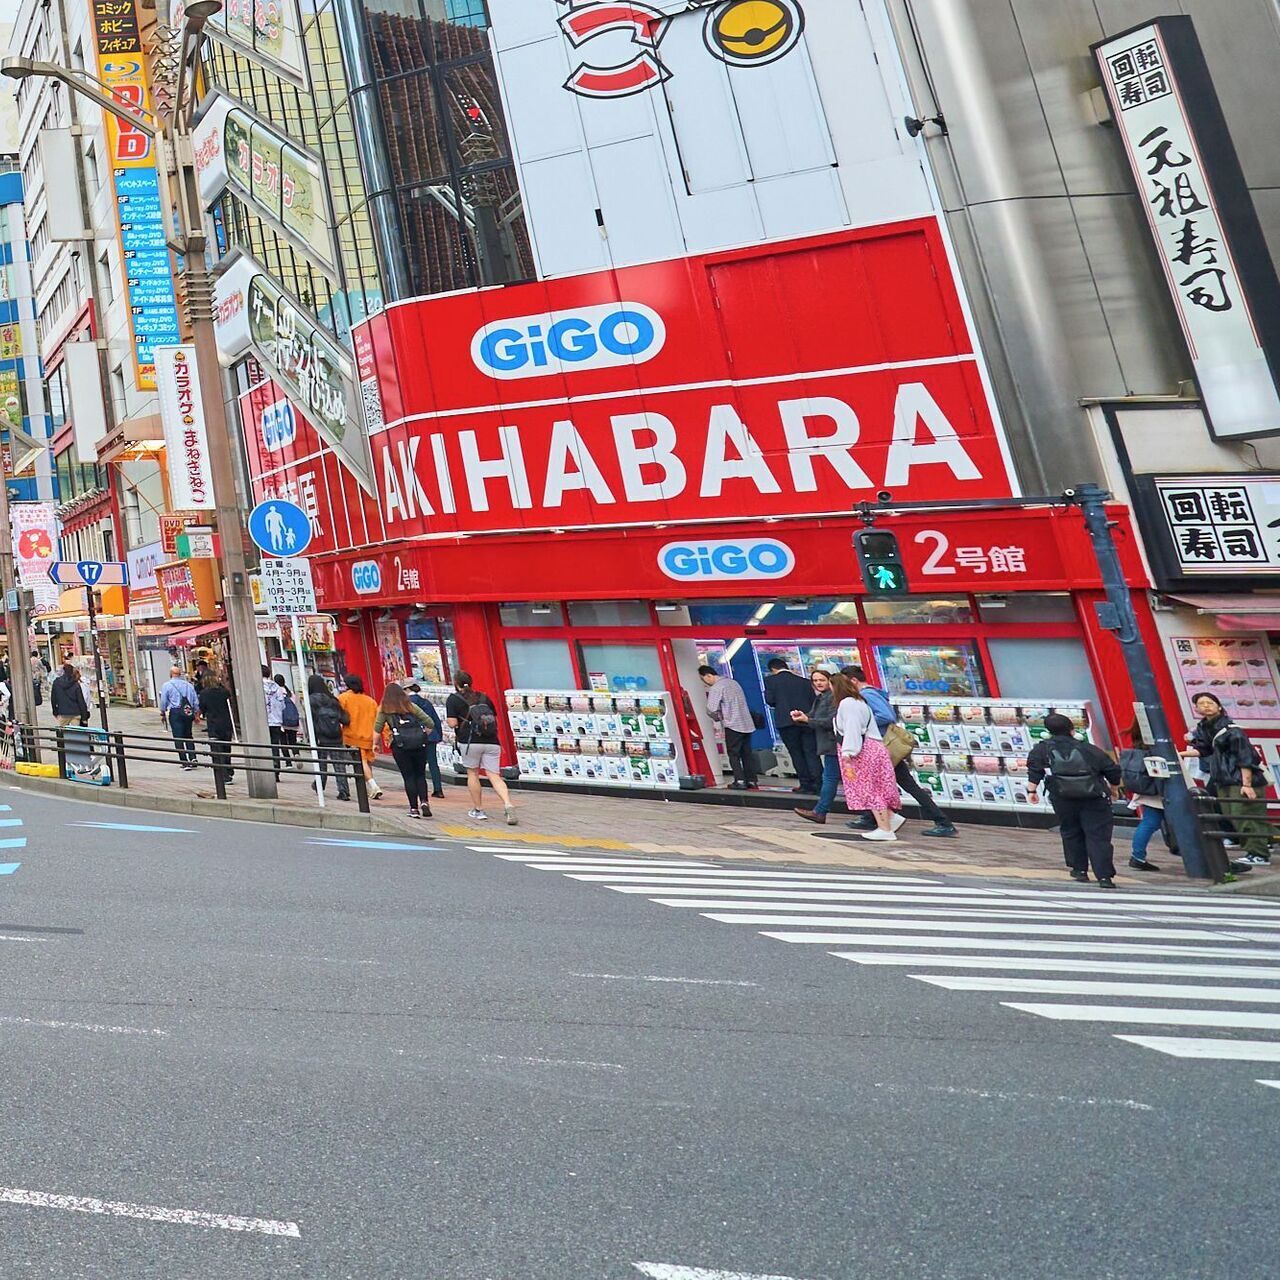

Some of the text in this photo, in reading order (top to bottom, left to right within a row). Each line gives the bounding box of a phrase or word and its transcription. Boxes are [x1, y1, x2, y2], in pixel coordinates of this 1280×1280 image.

[96, 1, 132, 16] コミック
[100, 19, 133, 34] ホビー
[100, 37, 137, 52] フィギュア
[1111, 41, 1161, 81] 回転
[1121, 70, 1168, 107] 寿司
[238, 138, 296, 209] カラオケ
[1138, 126, 1233, 313] 元祖寿司
[479, 310, 656, 372] GiGO
[175, 362, 206, 505] カラオケ まねきねこ
[263, 405, 295, 447] GiGO
[382, 382, 984, 524] AKIHABARA
[1167, 491, 1249, 523] 回転
[664, 543, 789, 576] GiGO
[914, 530, 1027, 576] 2号館
[1180, 526, 1261, 561] 寿司
[82, 564, 99, 580] 17
[265, 560, 292, 570] 日曜の
[353, 563, 380, 591] GiGO
[394, 555, 420, 592] 2号館
[271, 605, 313, 613] 特定禁止区間
[612, 674, 648, 689] GiGO
[905, 678, 951, 693] GiGO
